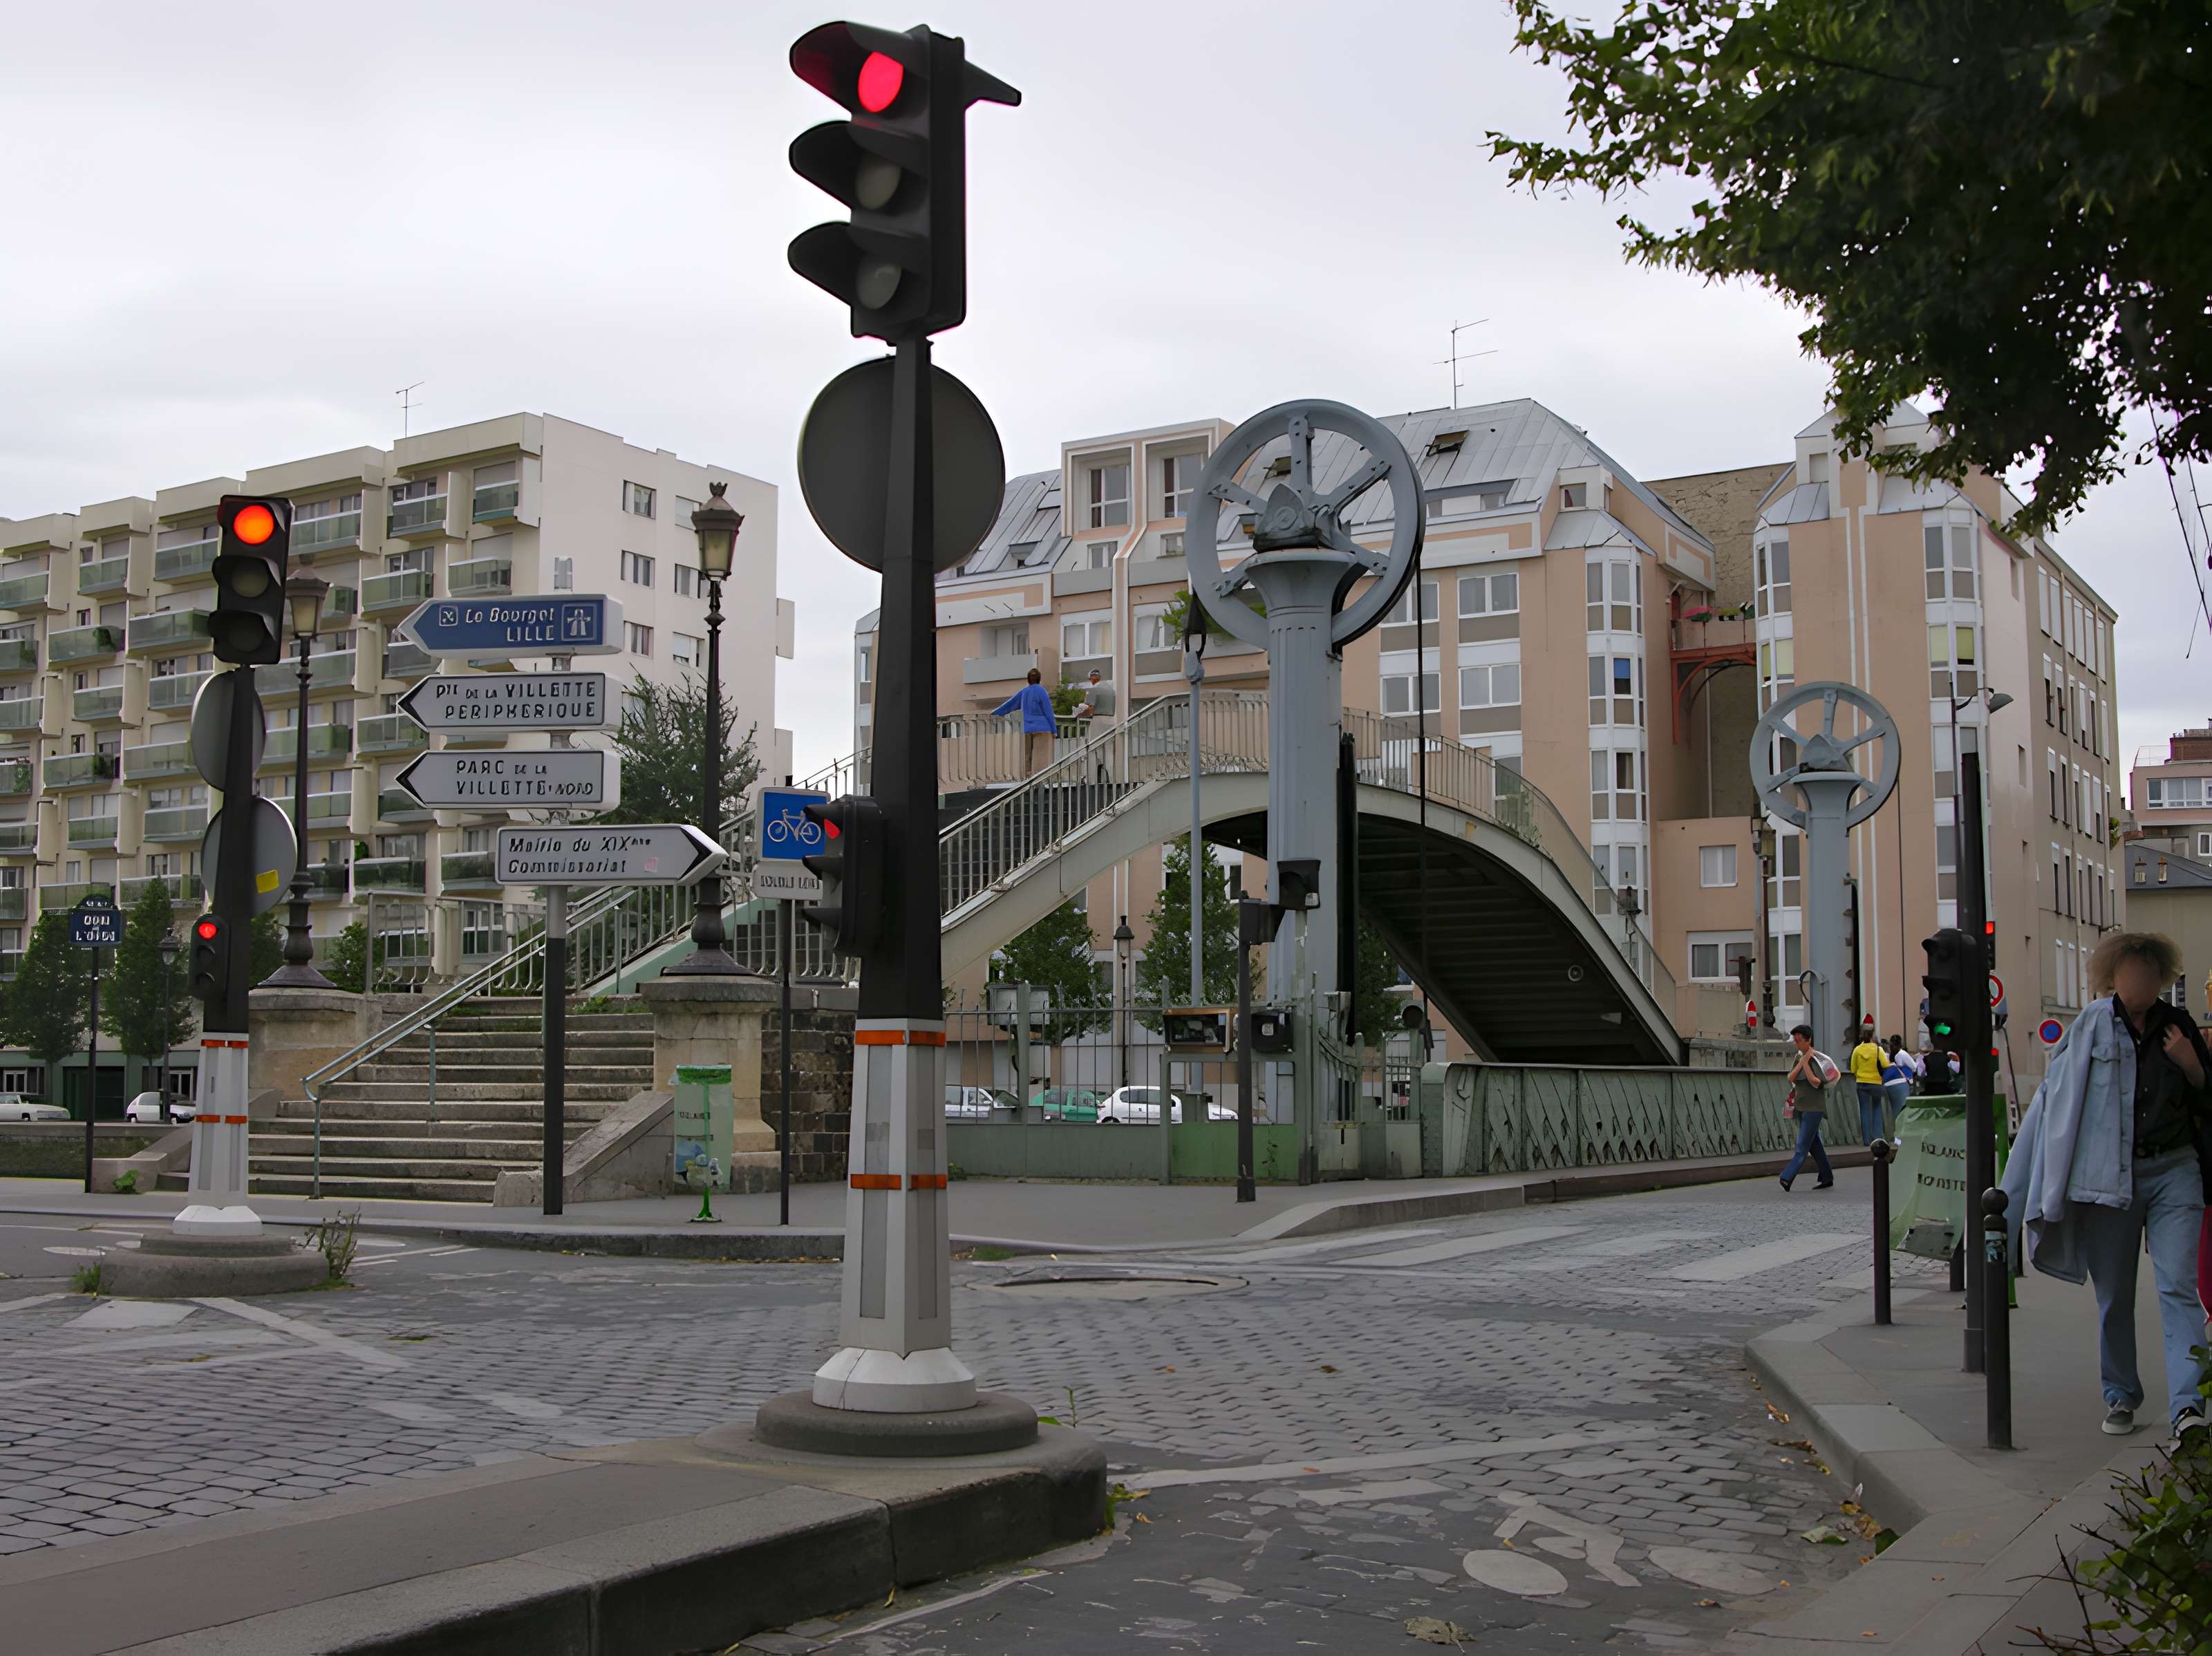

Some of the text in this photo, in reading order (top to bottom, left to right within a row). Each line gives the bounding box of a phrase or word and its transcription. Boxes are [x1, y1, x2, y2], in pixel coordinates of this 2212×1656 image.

[506, 626, 554, 642] LILLE
[505, 681, 595, 698] VILLETTE
[456, 760, 504, 775] PARC
[572, 837, 590, 852] du
